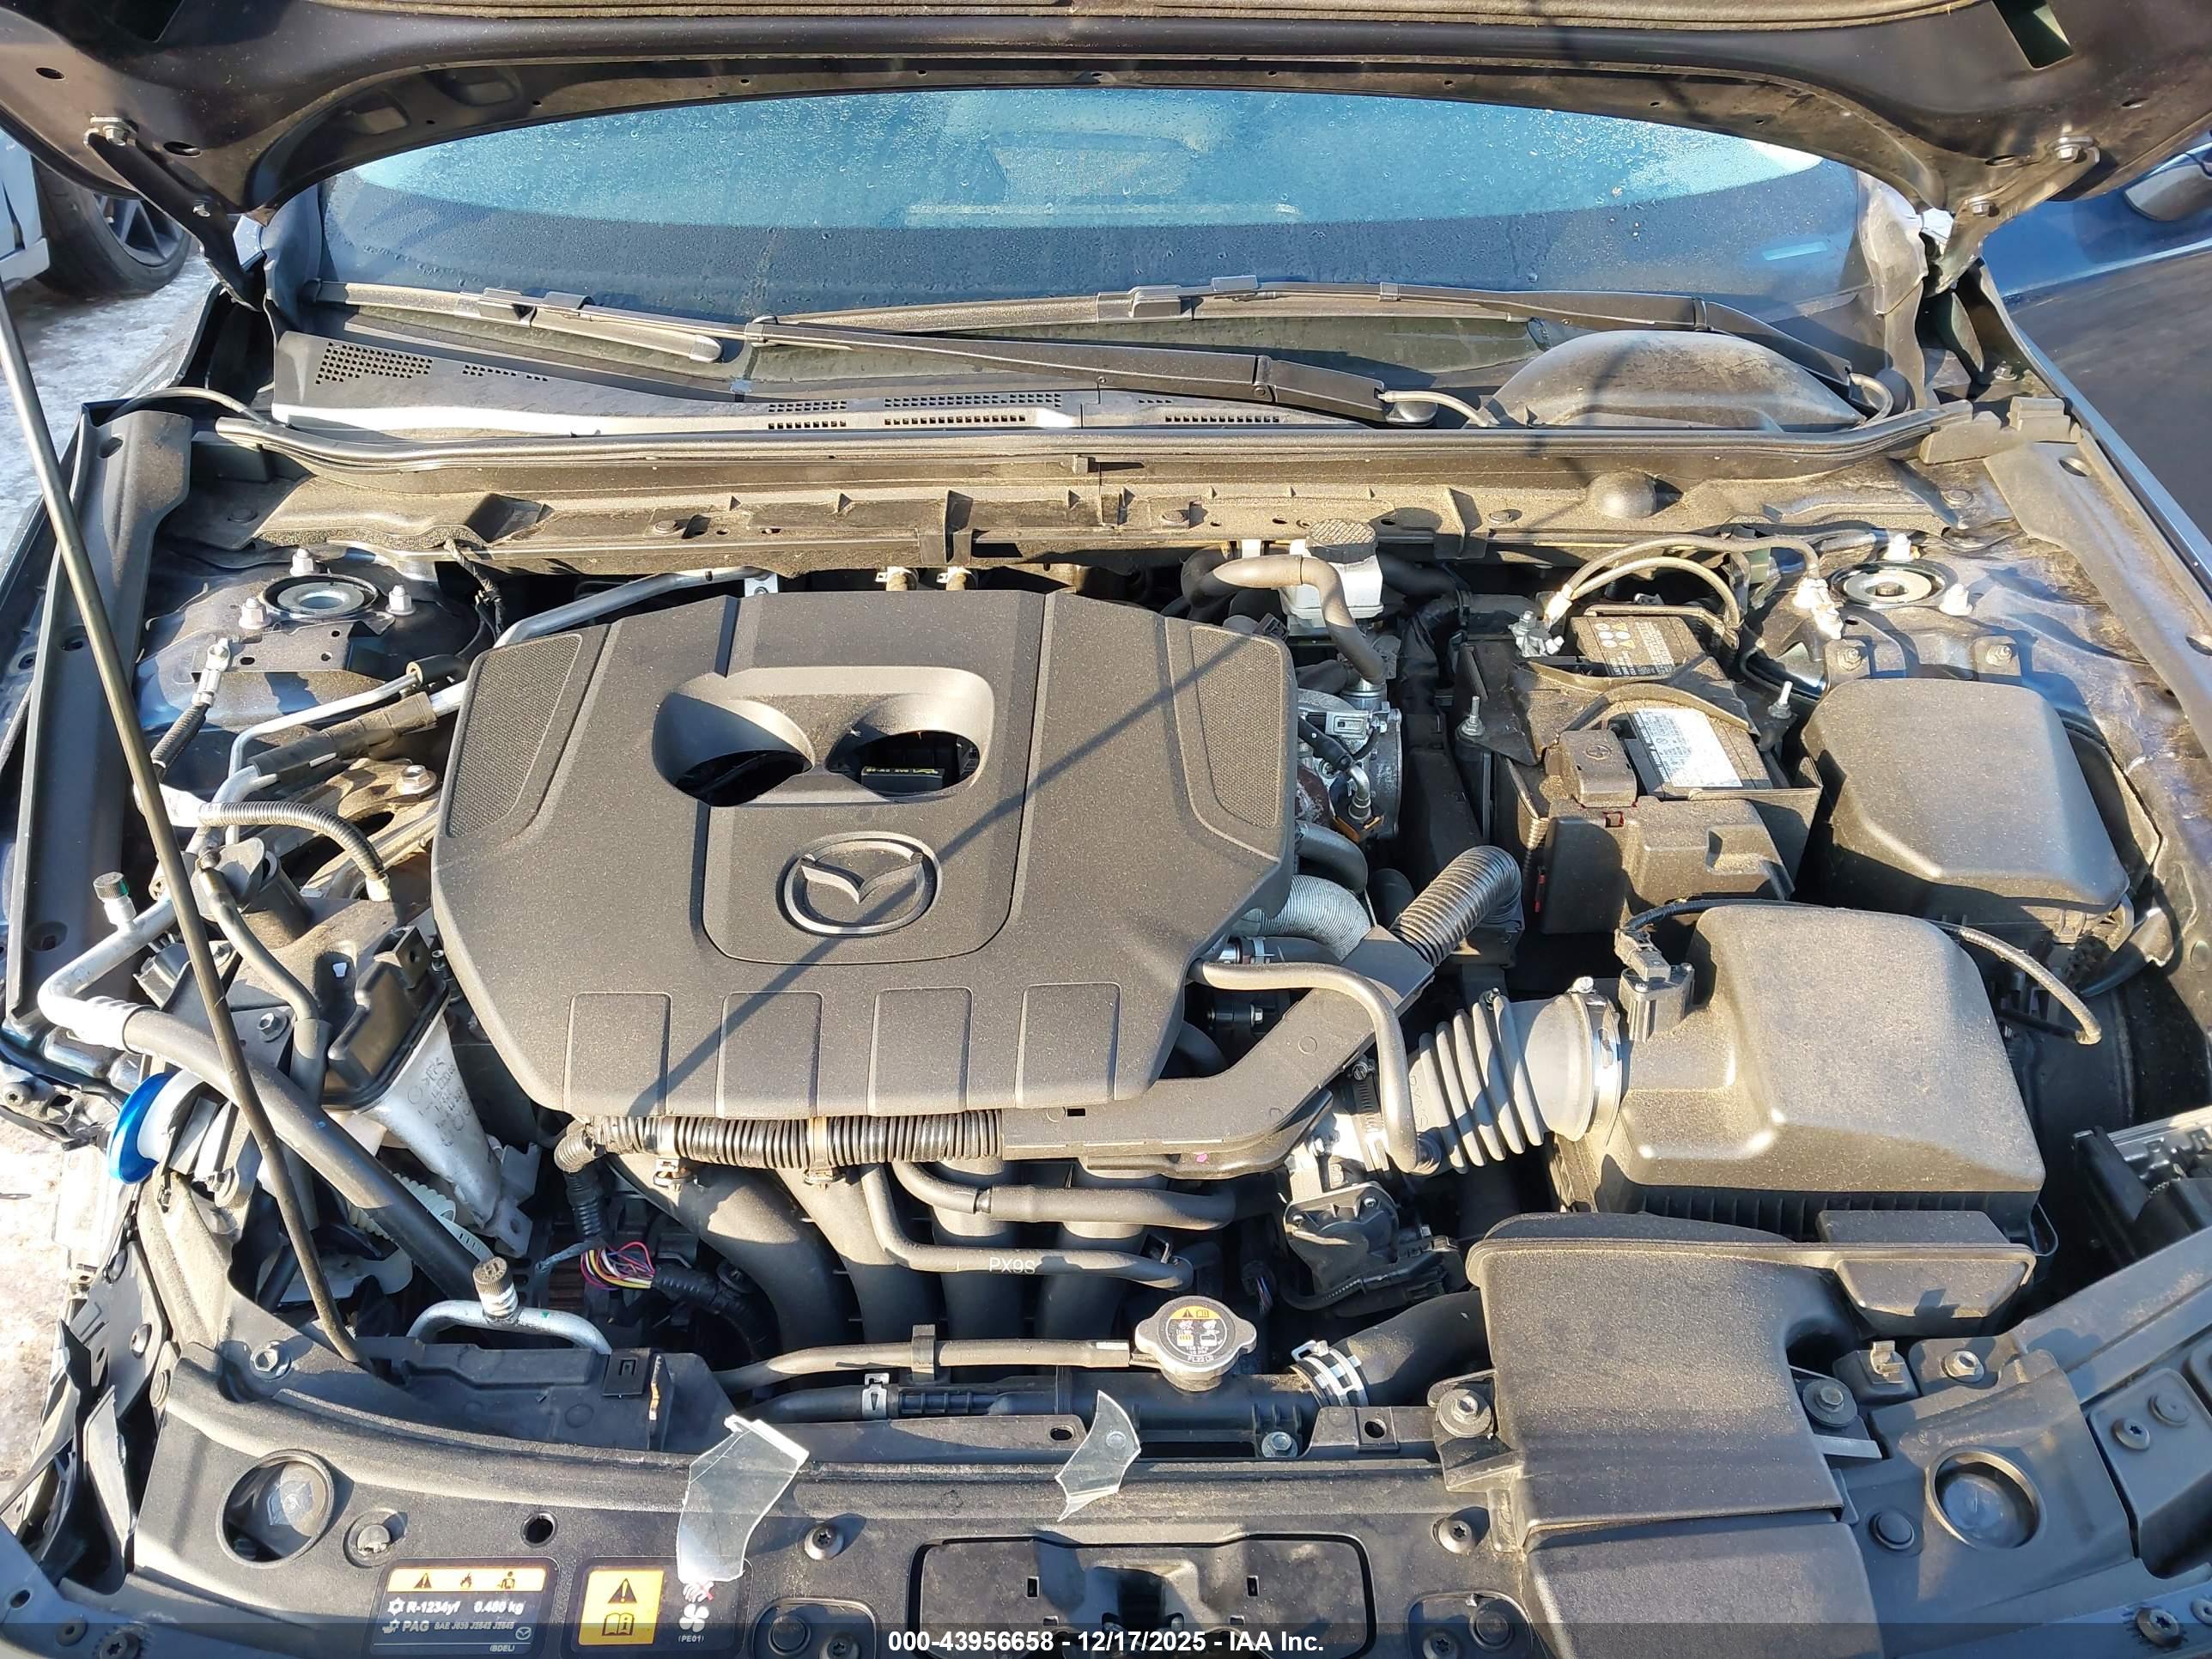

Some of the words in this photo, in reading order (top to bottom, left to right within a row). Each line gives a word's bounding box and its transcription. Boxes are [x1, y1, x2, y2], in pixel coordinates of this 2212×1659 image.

[406, 1601, 461, 1615] R-1234yf
[507, 1601, 525, 1615] kg
[402, 1620, 429, 1632] PAG
[434, 1621, 451, 1630] SAE
